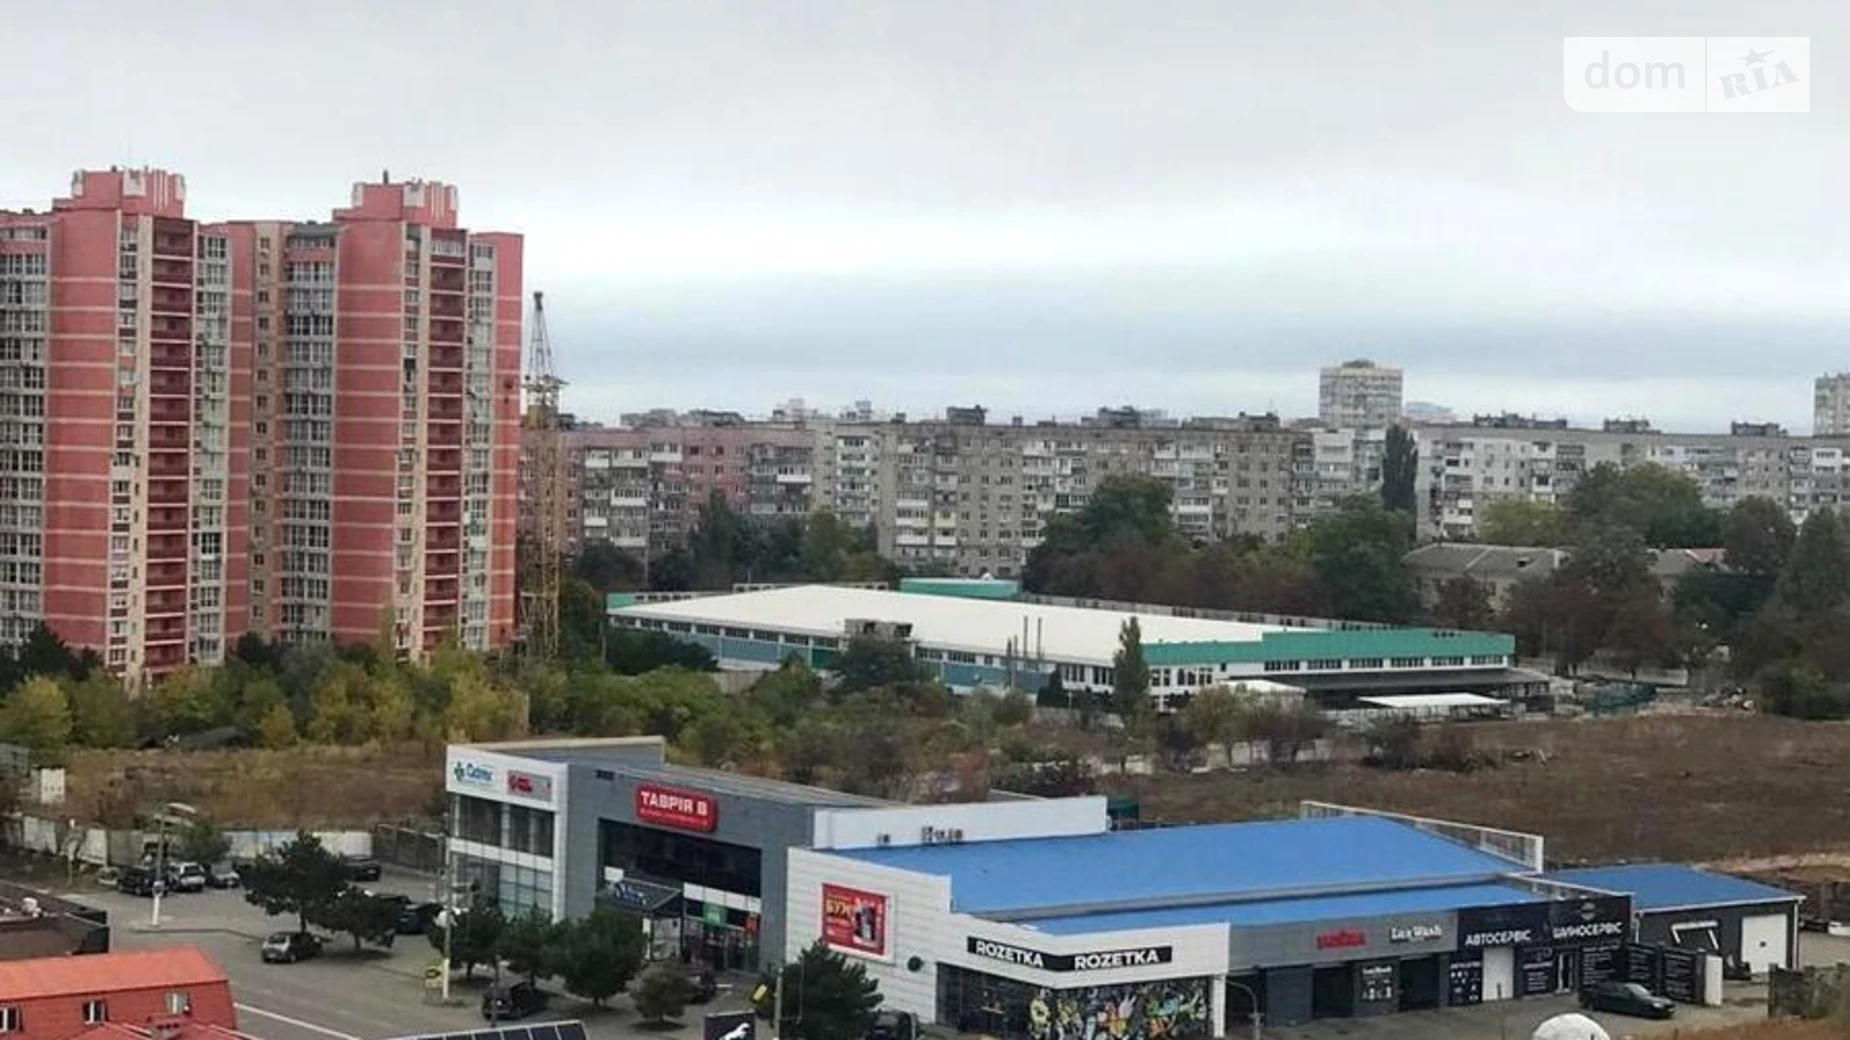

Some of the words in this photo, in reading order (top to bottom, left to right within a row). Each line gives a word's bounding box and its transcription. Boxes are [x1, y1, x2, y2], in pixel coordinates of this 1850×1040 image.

[1464, 929, 1532, 947] АВТОСЕРВІС
[975, 940, 1044, 968] ROZETKA
[1074, 948, 1160, 970] ROZETKA
